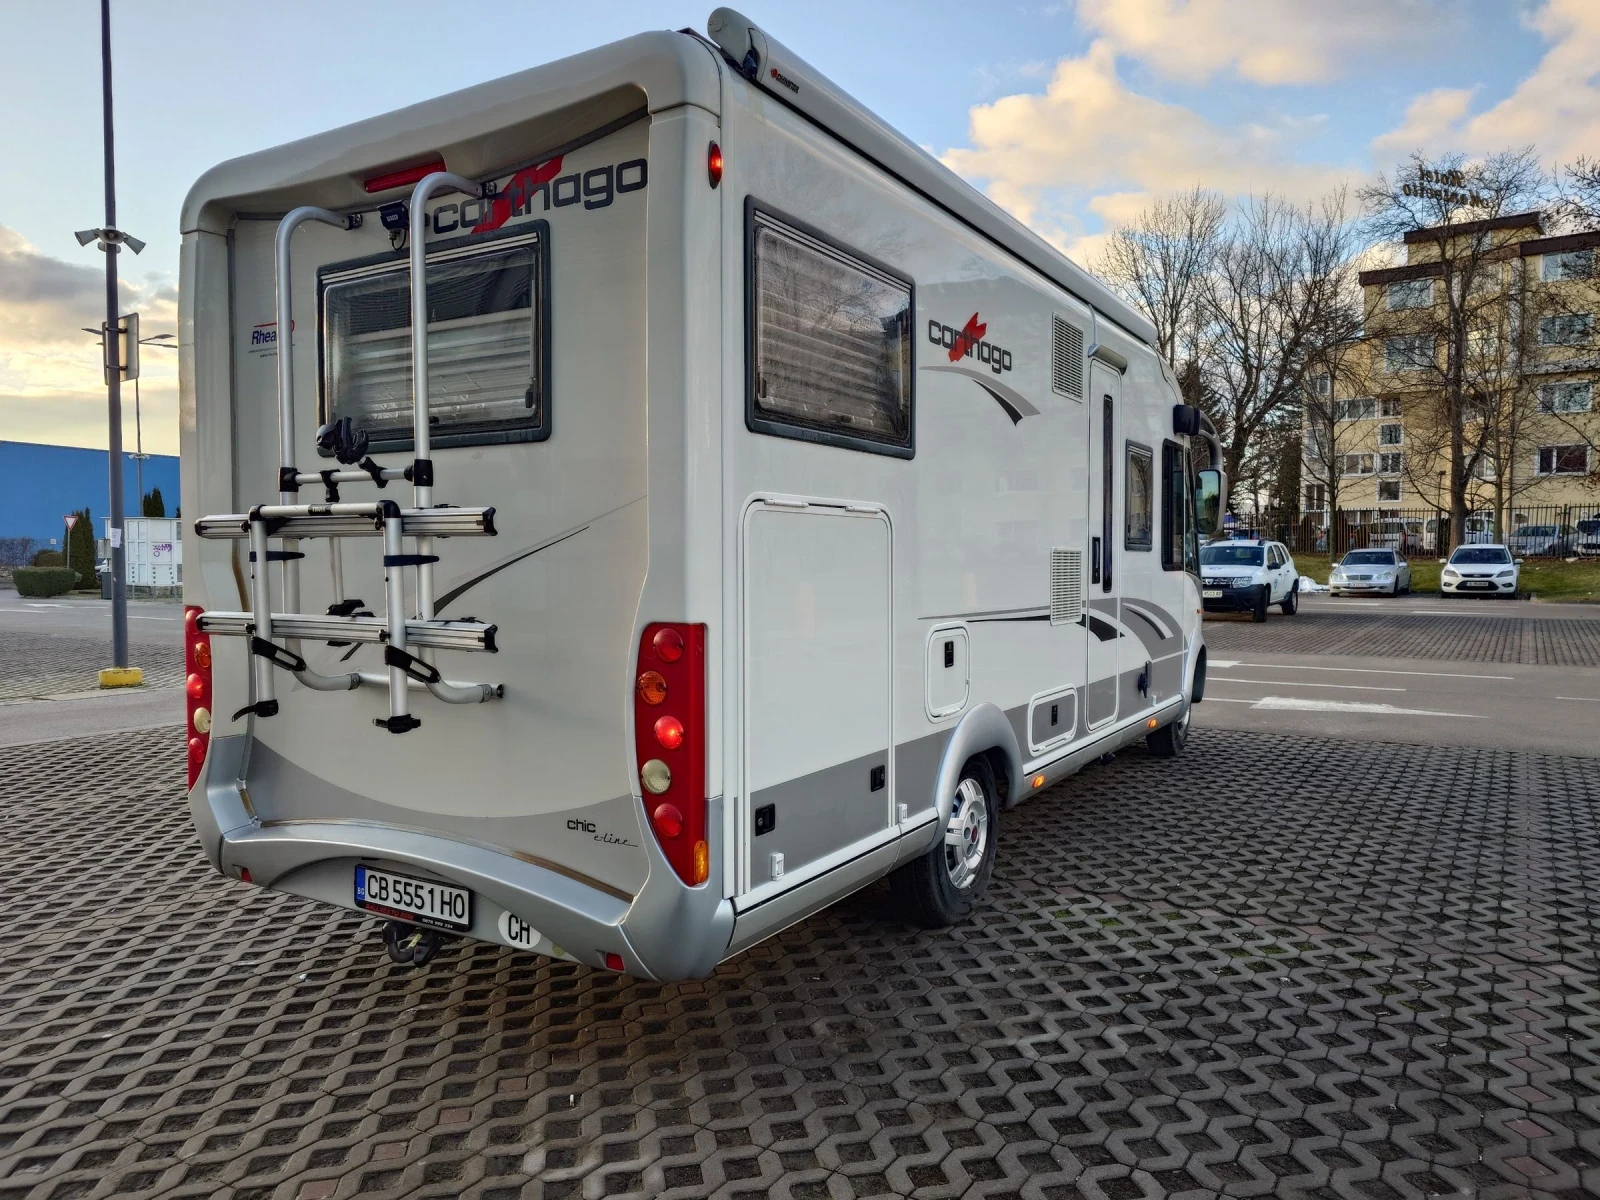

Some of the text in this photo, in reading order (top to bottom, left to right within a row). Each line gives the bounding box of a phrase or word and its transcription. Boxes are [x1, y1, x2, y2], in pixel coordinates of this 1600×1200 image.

[433, 157, 648, 235] carthago
[928, 319, 1012, 374] carthago
[567, 819, 596, 833] chic
[508, 913, 531, 945] CH
